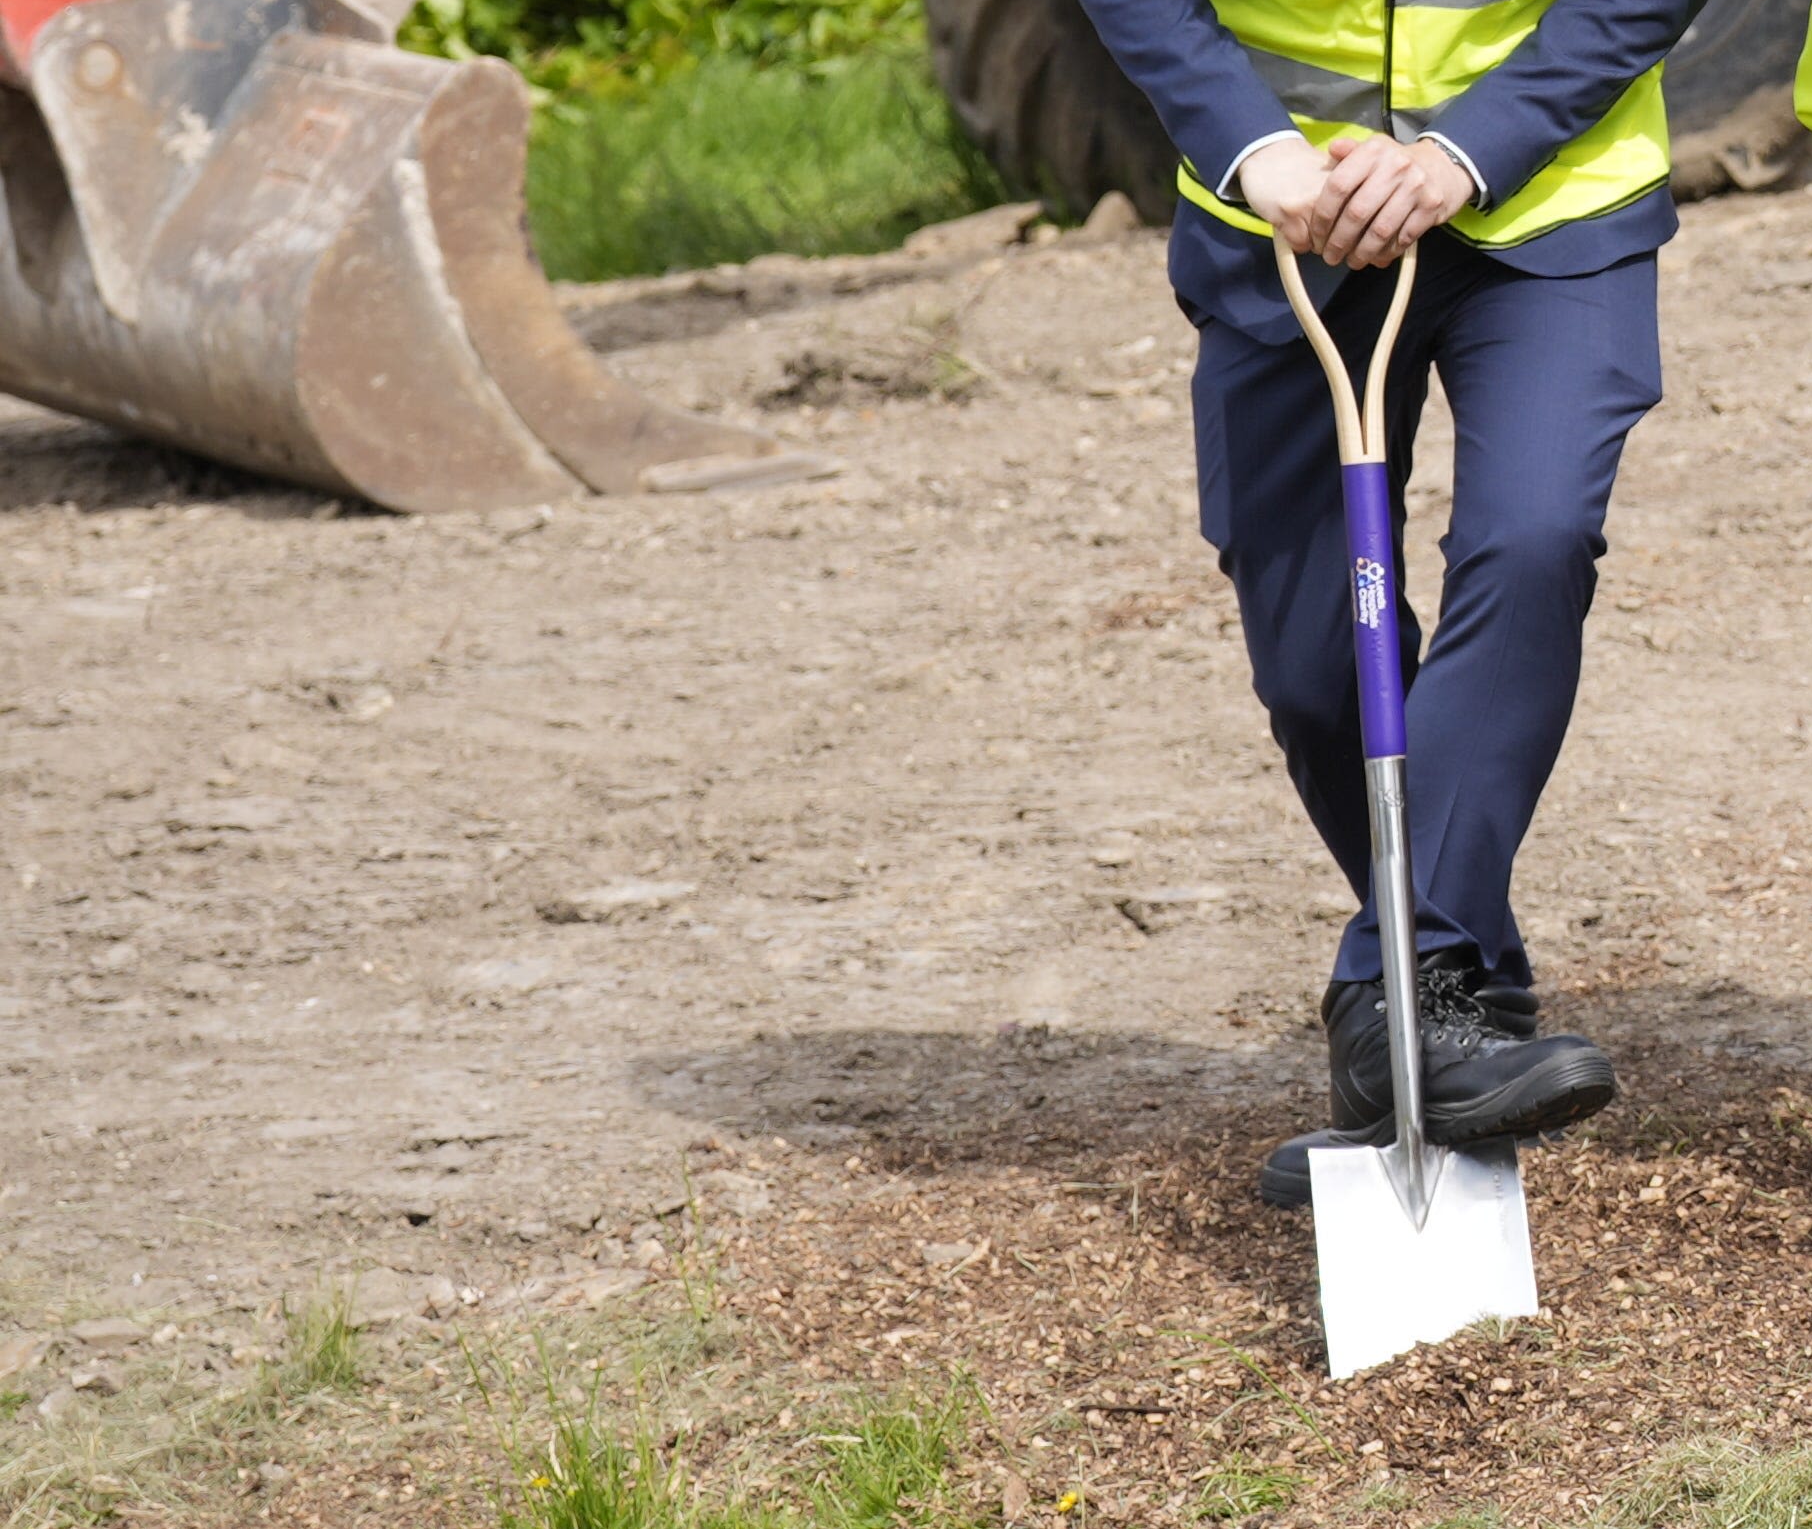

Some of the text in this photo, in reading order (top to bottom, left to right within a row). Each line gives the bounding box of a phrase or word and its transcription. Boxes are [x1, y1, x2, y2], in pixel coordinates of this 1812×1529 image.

[1358, 588, 1369, 624] Charity
[1367, 584, 1379, 628] Hospitals
[1375, 580, 1386, 610] Leeds
